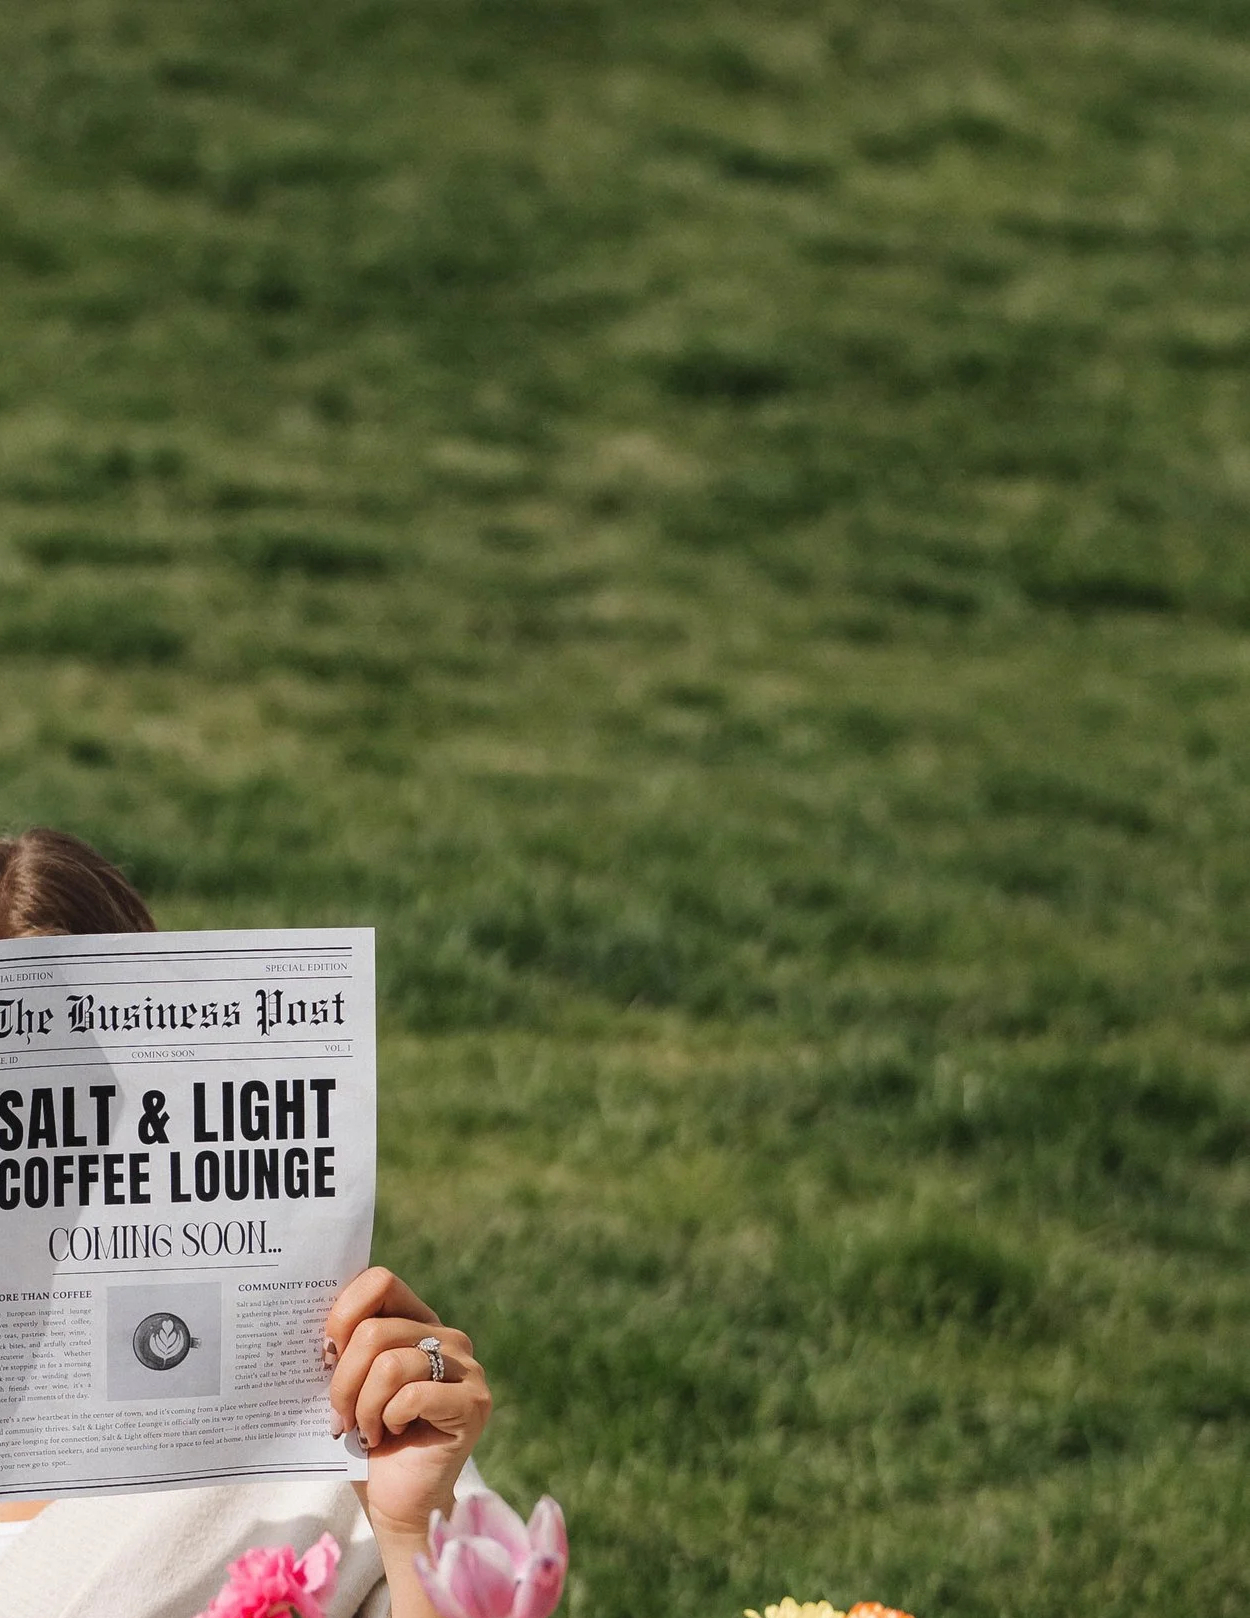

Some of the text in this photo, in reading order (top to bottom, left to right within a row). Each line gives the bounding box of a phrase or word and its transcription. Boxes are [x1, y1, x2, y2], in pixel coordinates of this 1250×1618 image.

[266, 962, 348, 973] SPECIAL EDITION
[17, 971, 53, 982] EDITION
[66, 994, 241, 1033] Business
[256, 989, 346, 1036] Post
[324, 1044, 344, 1052] VOL.
[131, 1049, 195, 1059] COMING SOON
[9, 1056, 19, 1064] ID
[138, 1089, 170, 1145] &
[193, 1078, 336, 1143] LIGHT
[170, 1147, 335, 1203] LOUNGE
[49, 1220, 282, 1262] COMING SOON...
[238, 1280, 337, 1292] COMMUNITY FOCUS
[21, 1292, 50, 1301] THAN
[52, 1291, 92, 1299] COFFEE
